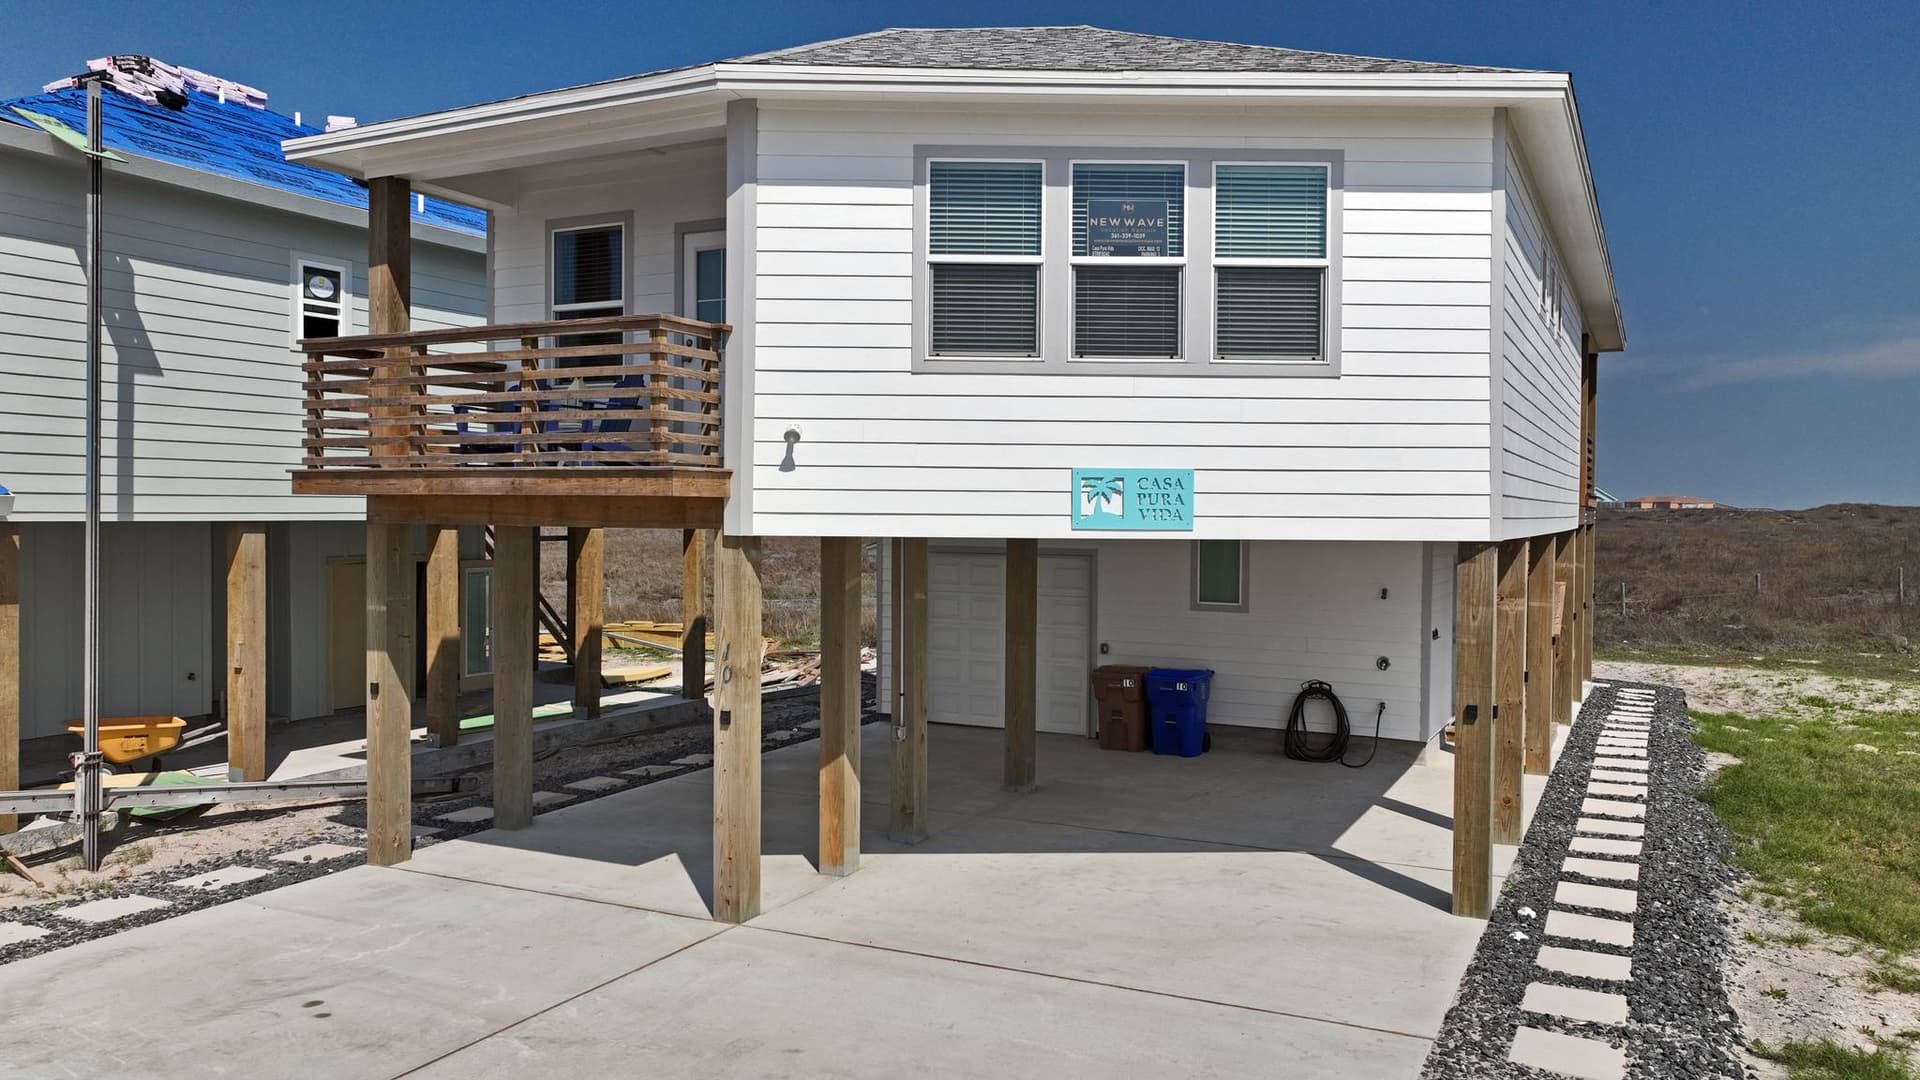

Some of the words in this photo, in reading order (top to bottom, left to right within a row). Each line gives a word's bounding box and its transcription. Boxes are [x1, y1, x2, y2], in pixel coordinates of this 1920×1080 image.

[1090, 217, 1121, 227] NEW
[1123, 217, 1165, 227] WAVE
[1136, 476, 1185, 490] CASA
[1136, 492, 1185, 506] PURA
[1138, 508, 1184, 521] VIDA
[1123, 679, 1134, 688] 10
[1176, 682, 1188, 691] 10
